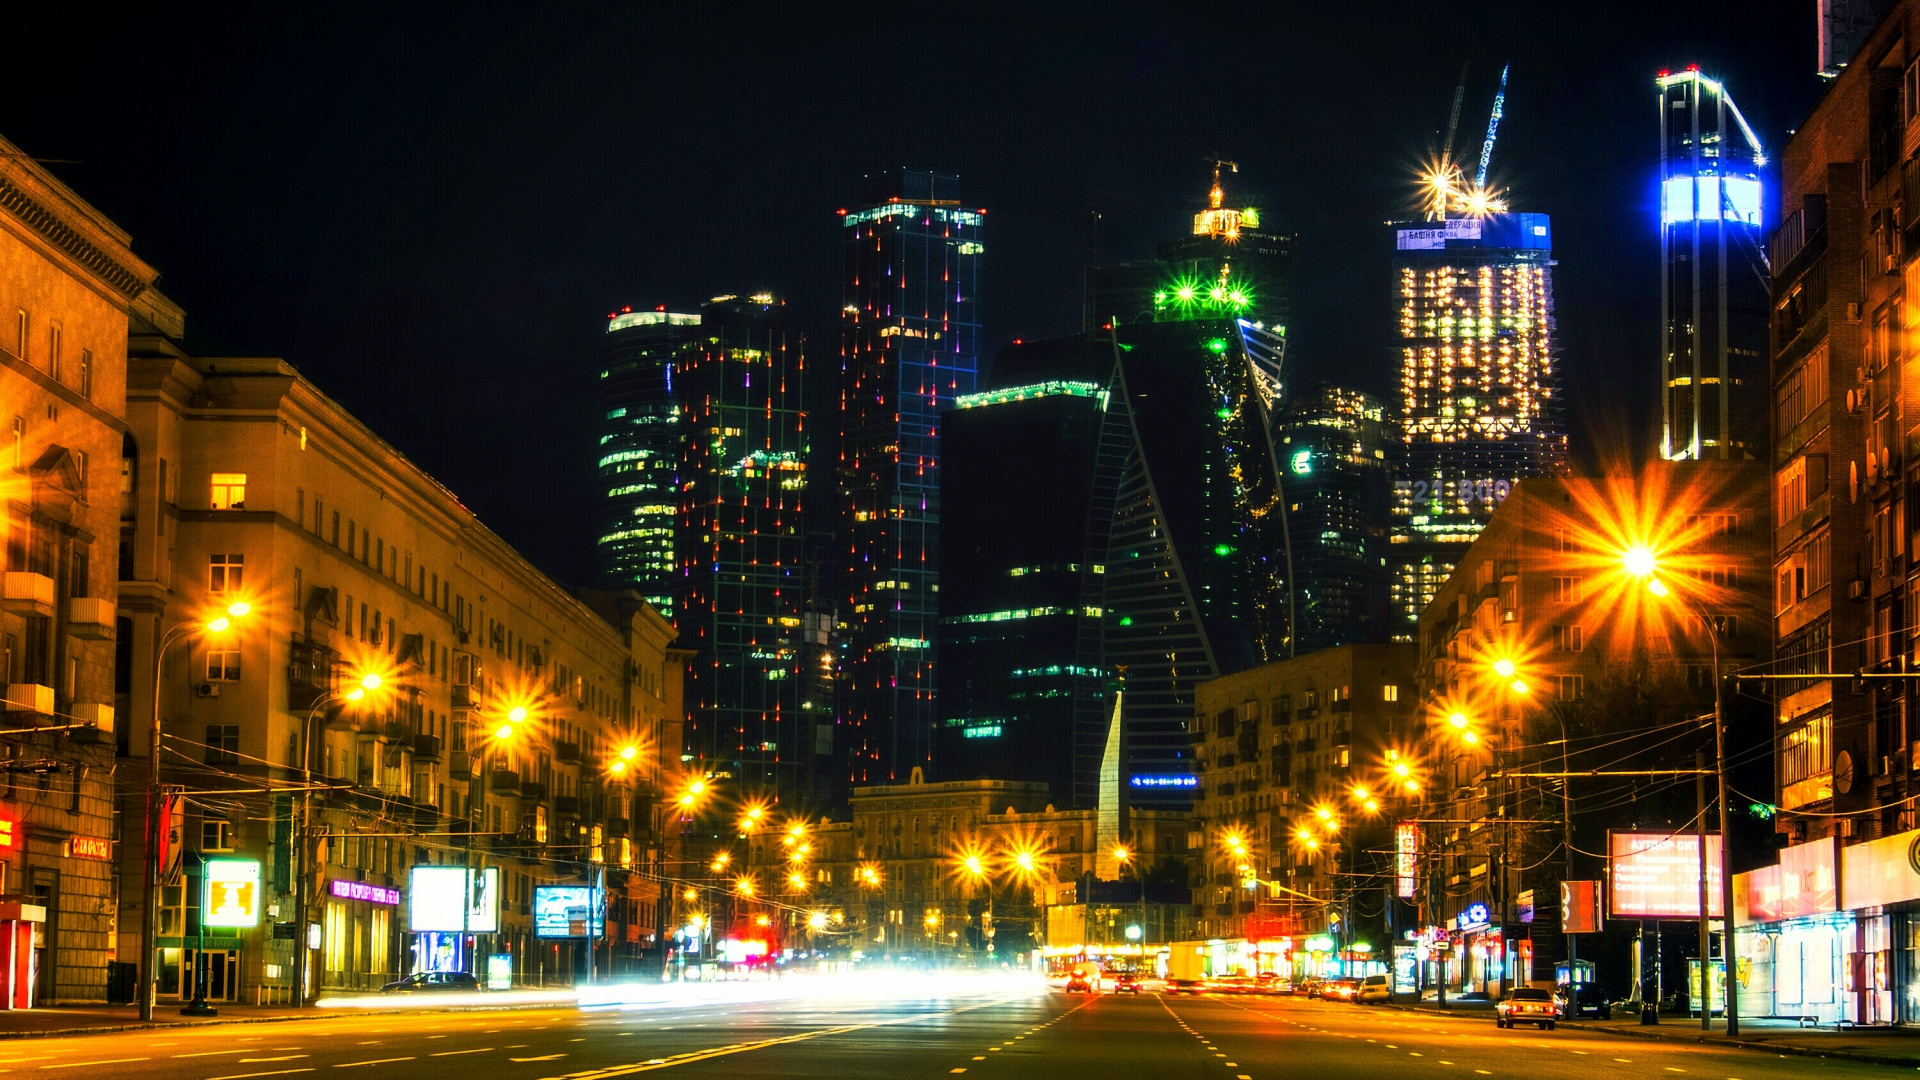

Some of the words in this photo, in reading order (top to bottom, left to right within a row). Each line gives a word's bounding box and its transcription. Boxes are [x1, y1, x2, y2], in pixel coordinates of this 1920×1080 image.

[1409, 231, 1435, 240] БАШНЯ
[1631, 840, 1675, 851] АУТДОР
[1677, 840, 1699, 851] СИТ
